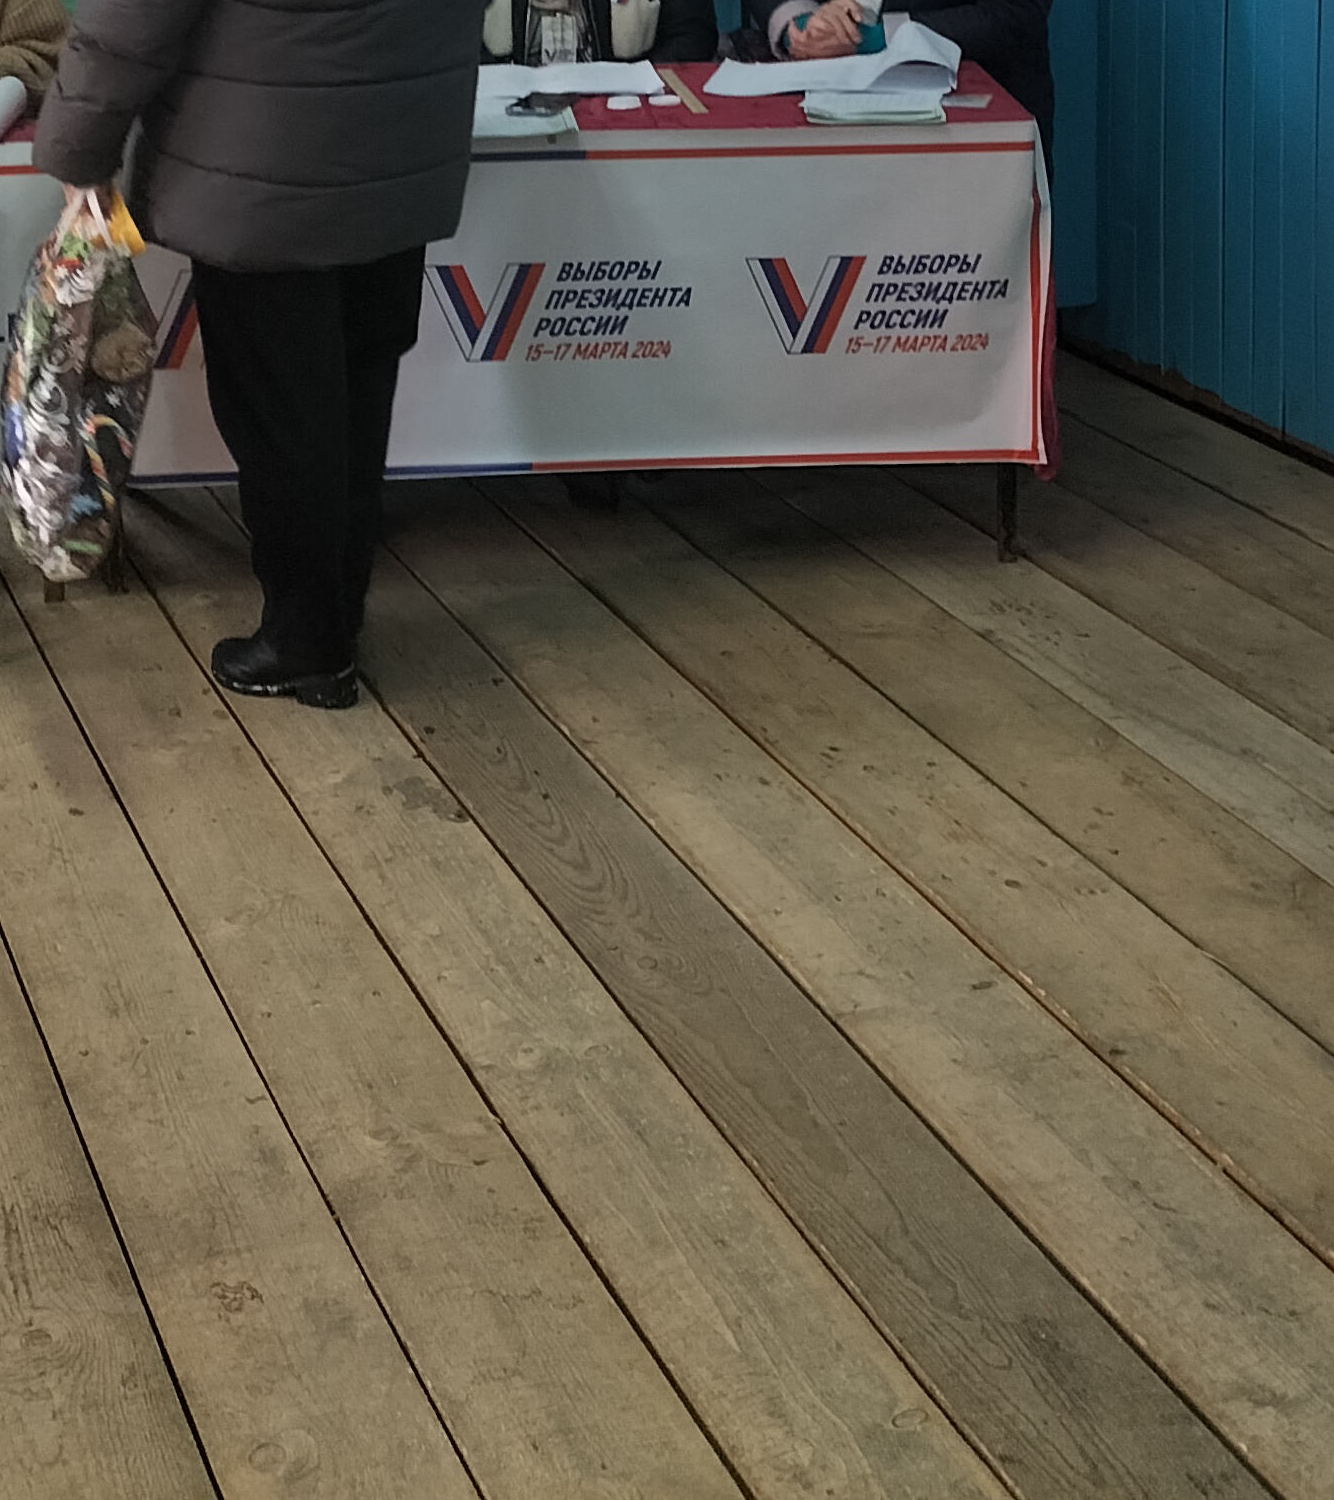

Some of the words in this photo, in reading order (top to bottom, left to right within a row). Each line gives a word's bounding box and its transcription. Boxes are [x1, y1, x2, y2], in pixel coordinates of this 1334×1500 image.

[556, 260, 662, 283] ВЫБОРЫ
[877, 253, 982, 276] ВЫБОРЫ
[544, 286, 693, 310] ПРЕЗИДЕНТА
[865, 278, 1009, 304] ПРЕЗИДЕНТА
[533, 315, 629, 338] РОССИИ
[853, 308, 948, 330] РОССИИ
[573, 341, 629, 361] МАРТА
[631, 340, 672, 359] 2024
[892, 334, 948, 354] МАРТА
[950, 332, 989, 352] 2024
